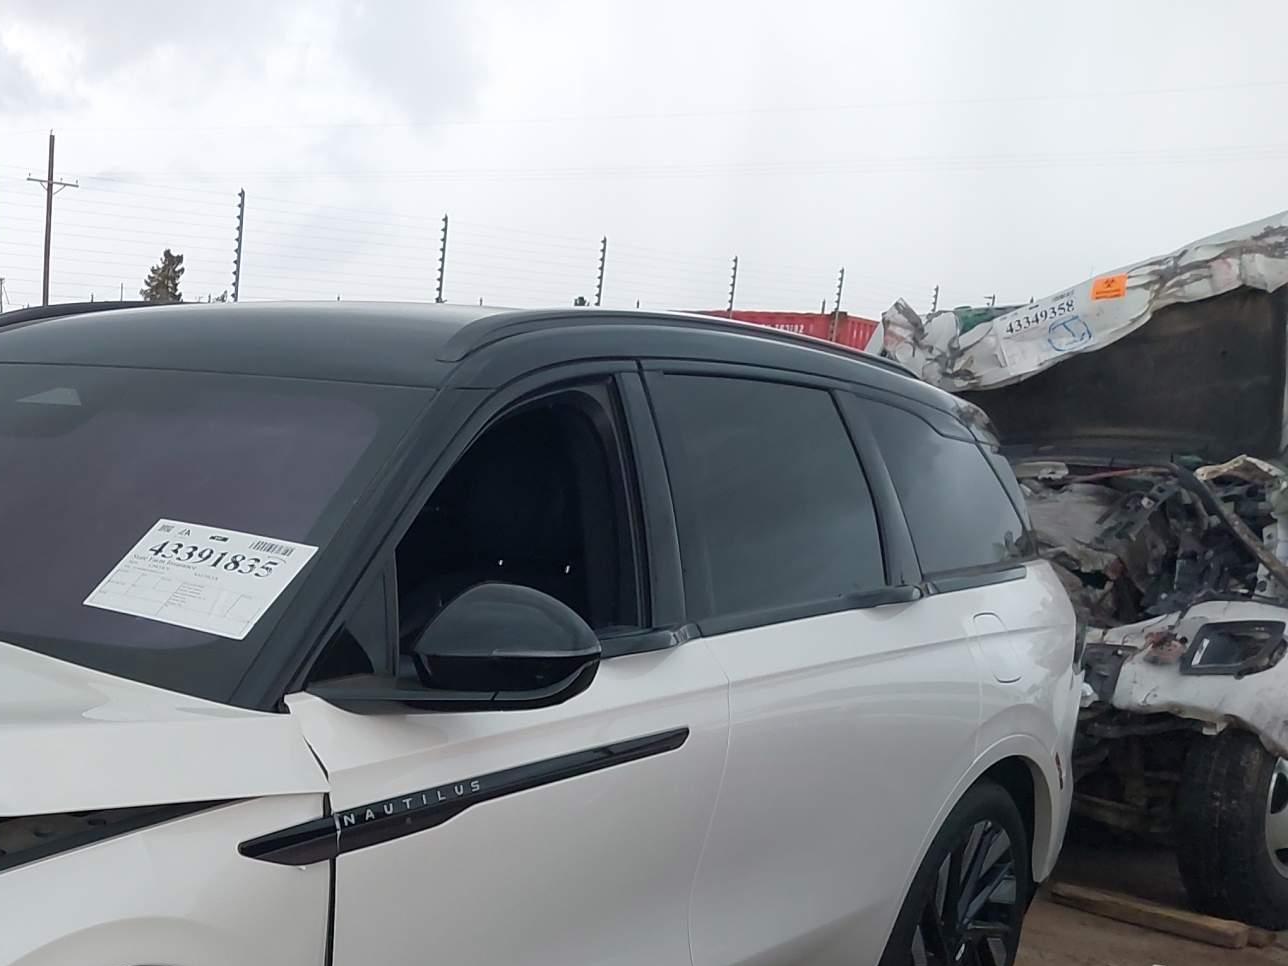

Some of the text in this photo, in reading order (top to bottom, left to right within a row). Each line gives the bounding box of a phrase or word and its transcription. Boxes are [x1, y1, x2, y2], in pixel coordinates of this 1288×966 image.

[1005, 299, 1076, 334] 43349358
[149, 540, 279, 578] 43391835
[343, 780, 481, 827] NAUTILUS
